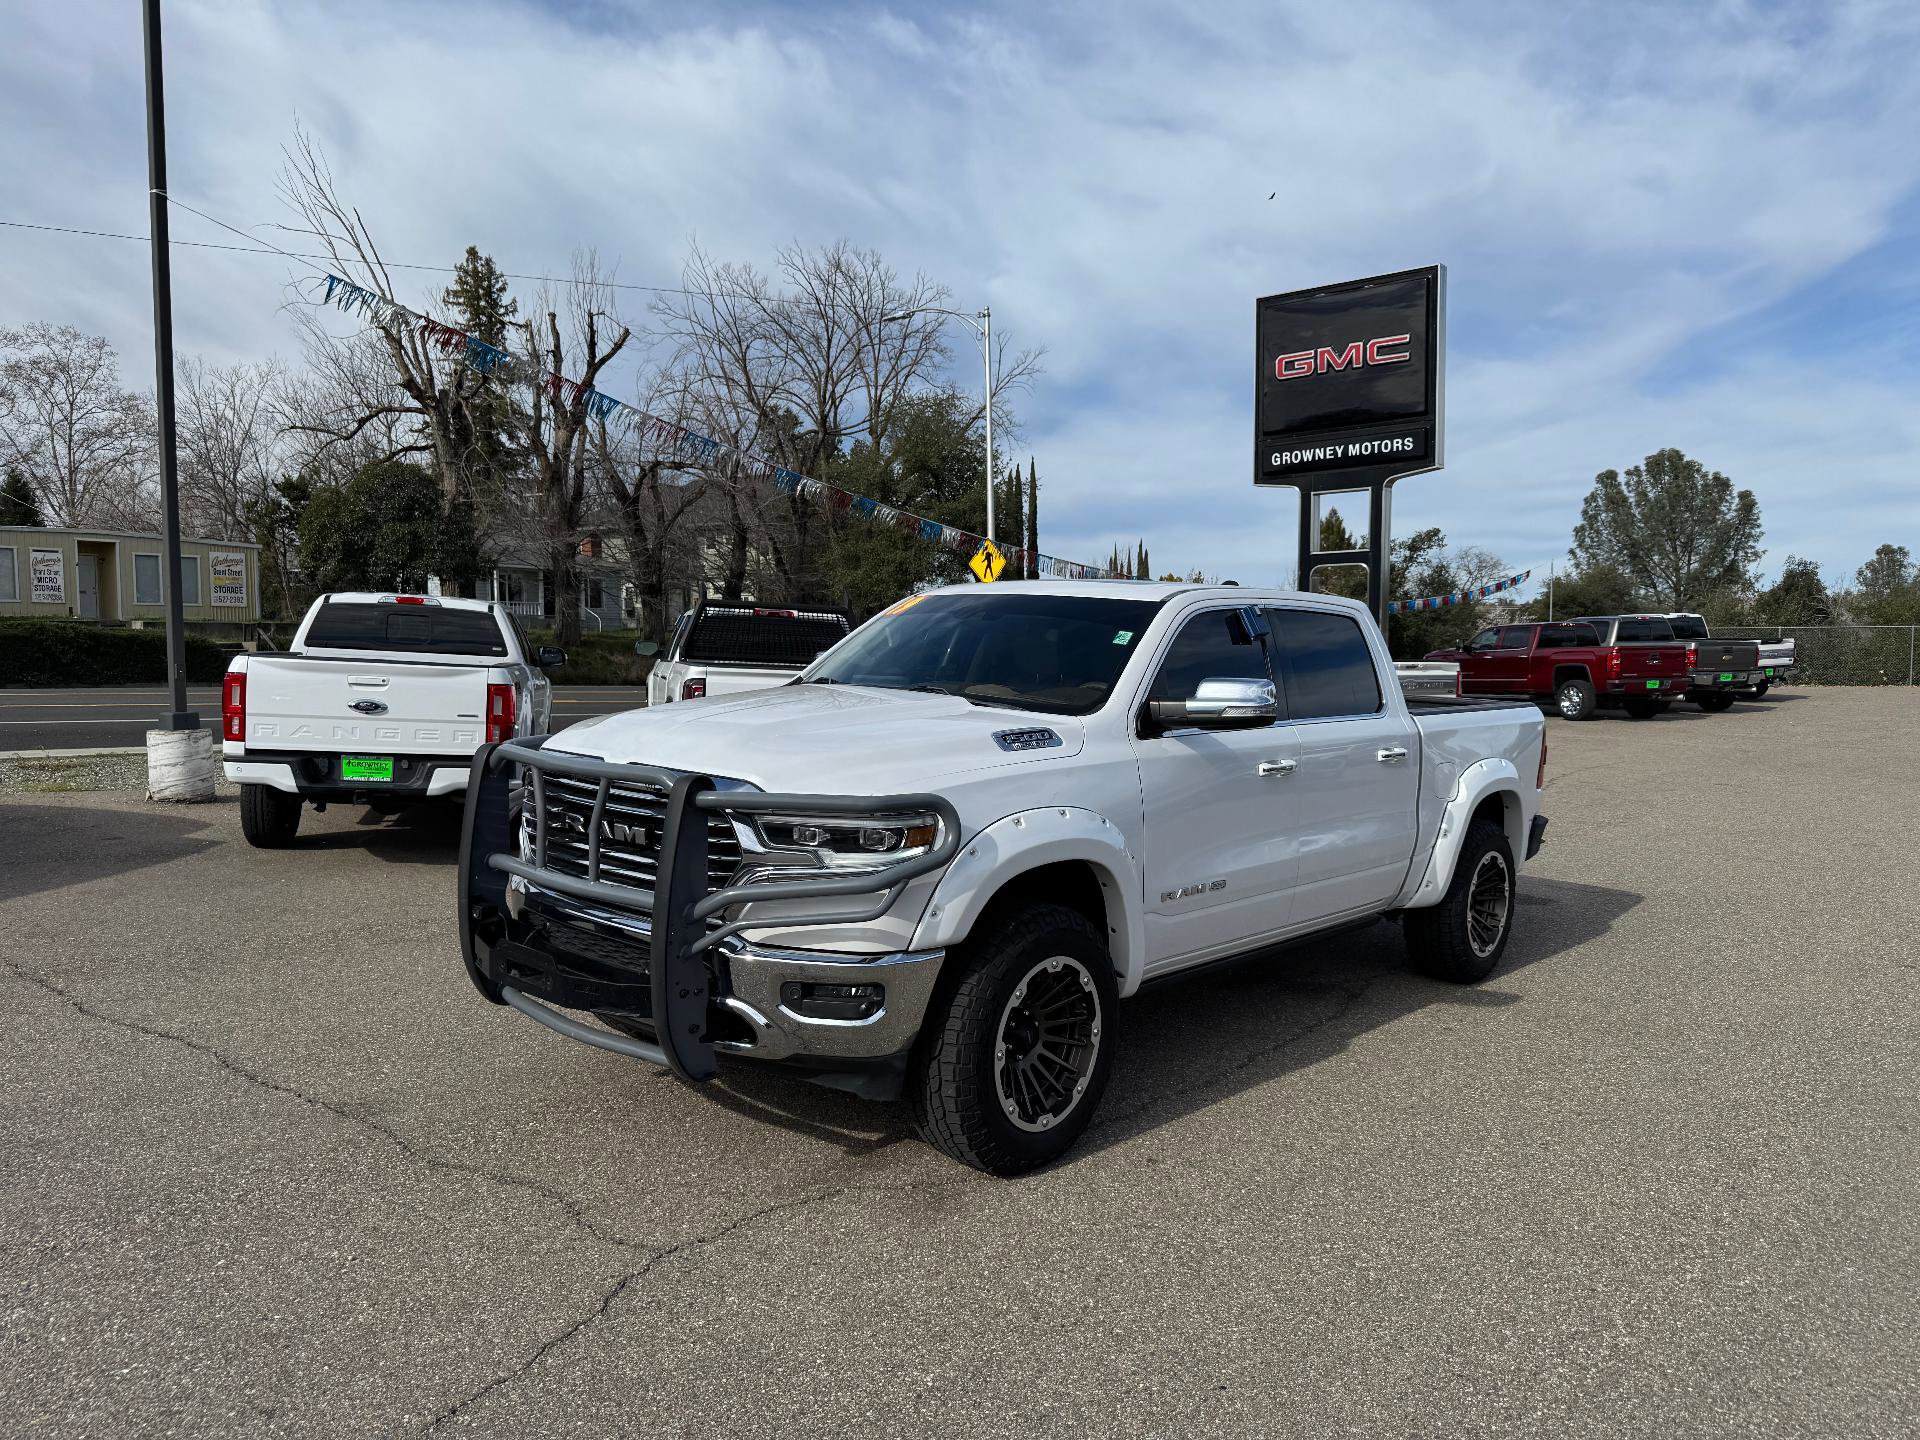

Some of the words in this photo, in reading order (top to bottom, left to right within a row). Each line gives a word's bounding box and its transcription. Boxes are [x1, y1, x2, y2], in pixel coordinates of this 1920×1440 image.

[1275, 333, 1410, 380] GMC
[1271, 444, 1344, 465] GROWNEY
[1348, 437, 1414, 457] MOTORS
[37, 576, 58, 584] MICRO
[34, 584, 62, 593] STORAGE
[213, 585, 244, 594] STORAGE
[253, 722, 479, 743] RANGER
